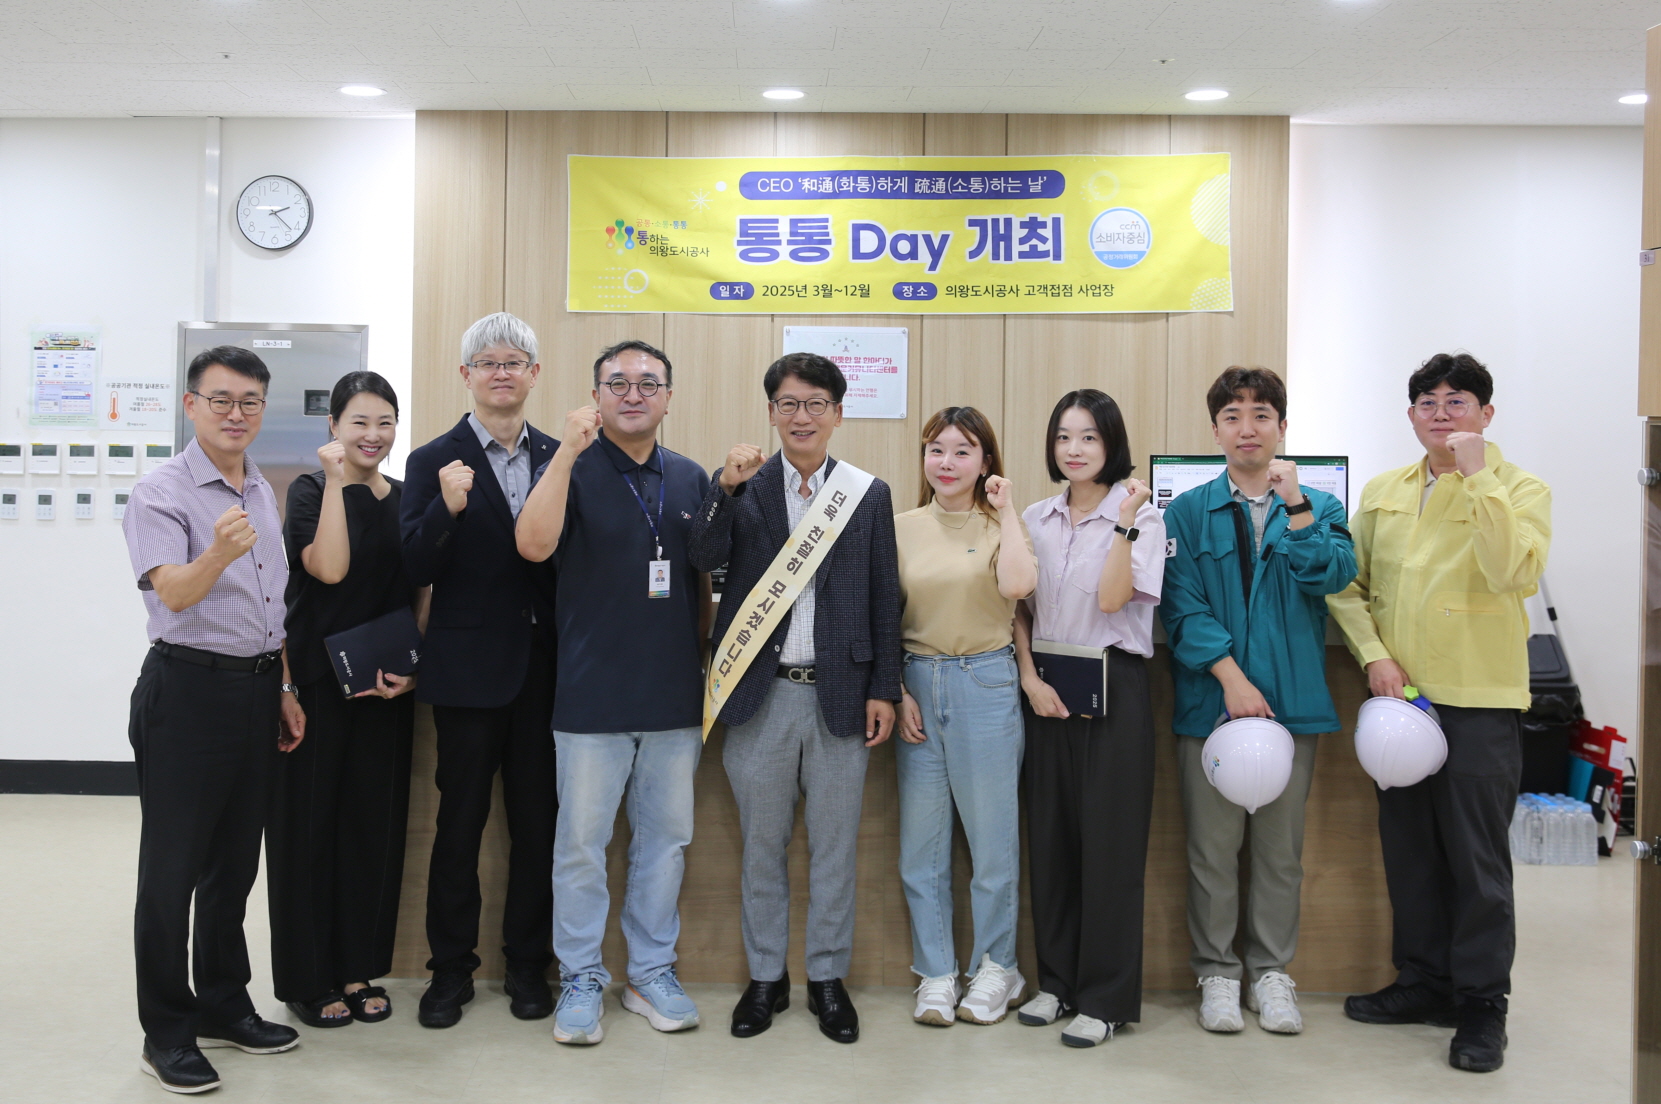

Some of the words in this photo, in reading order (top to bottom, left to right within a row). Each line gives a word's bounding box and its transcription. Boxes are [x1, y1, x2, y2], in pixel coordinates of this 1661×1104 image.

[269, 181, 280, 192] 12
[757, 178, 794, 193] CEO
[636, 230, 670, 246] 통하는
[736, 217, 832, 263] 통통
[851, 223, 951, 272] Day
[967, 216, 1062, 262] 개최
[1095, 232, 1146, 245] 소비자중심
[649, 245, 710, 258] 의왕도시공사
[762, 285, 808, 298] 2025년
[813, 284, 871, 298] 3월~12월
[945, 285, 1020, 298] 의왕도시공사
[1024, 284, 1074, 298] 고객접점
[1078, 284, 1115, 298] 사업장
[823, 490, 847, 521] 더욱
[786, 525, 825, 575] 친절히
[718, 580, 787, 678] 모시겠습니다
